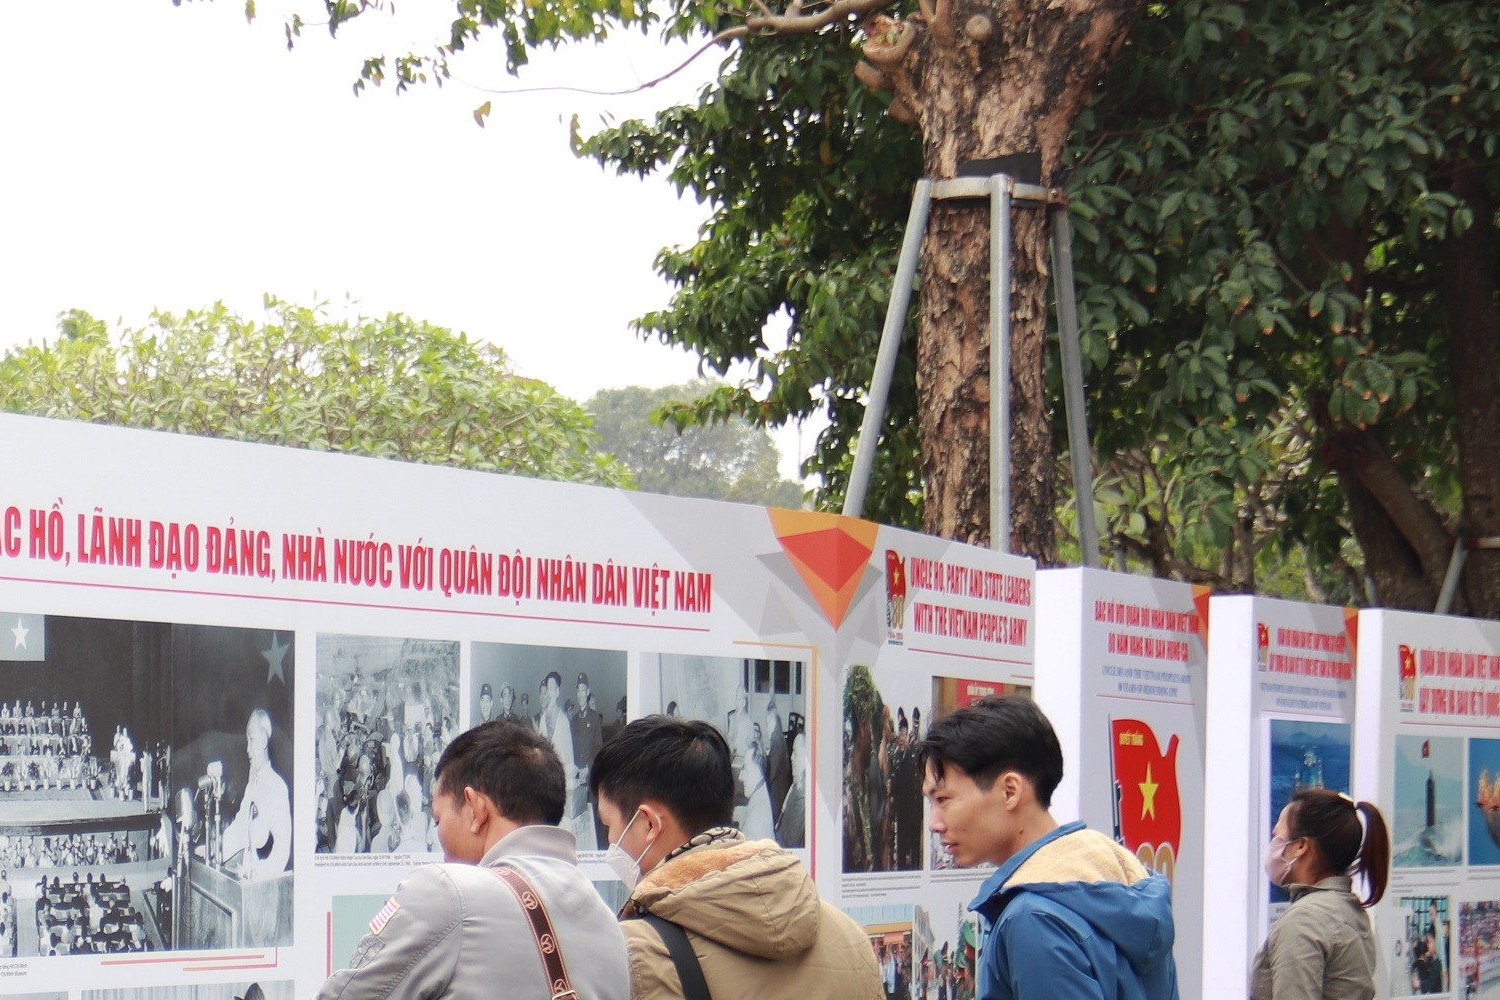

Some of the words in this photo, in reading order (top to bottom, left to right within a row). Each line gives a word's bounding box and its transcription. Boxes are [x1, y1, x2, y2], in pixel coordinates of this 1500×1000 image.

[30, 498, 71, 567] HỒ,
[78, 506, 141, 567] LÃNH
[149, 520, 197, 580] ĐẠO
[206, 516, 276, 583] ĐẢNG,
[282, 527, 326, 583] NHÀ
[334, 533, 392, 588] NƯỚC
[398, 536, 433, 591] VỚI
[440, 544, 492, 598] QUÂN
[498, 549, 530, 606] ĐỘI
[537, 554, 587, 604] NHÂN
[592, 558, 627, 606] DÂN
[632, 562, 669, 617] VIỆT
[674, 570, 712, 614] NAM
[911, 557, 932, 590] UNCLE
[934, 561, 945, 595] HO,
[947, 564, 969, 596] PARTY
[969, 569, 982, 599] AND
[984, 571, 1002, 602] STATE
[1004, 574, 1031, 607] LEADERS
[914, 602, 932, 634] WITH
[935, 606, 947, 636] THE
[949, 608, 978, 640] VIETNAM
[1009, 617, 1027, 647] ARMY
